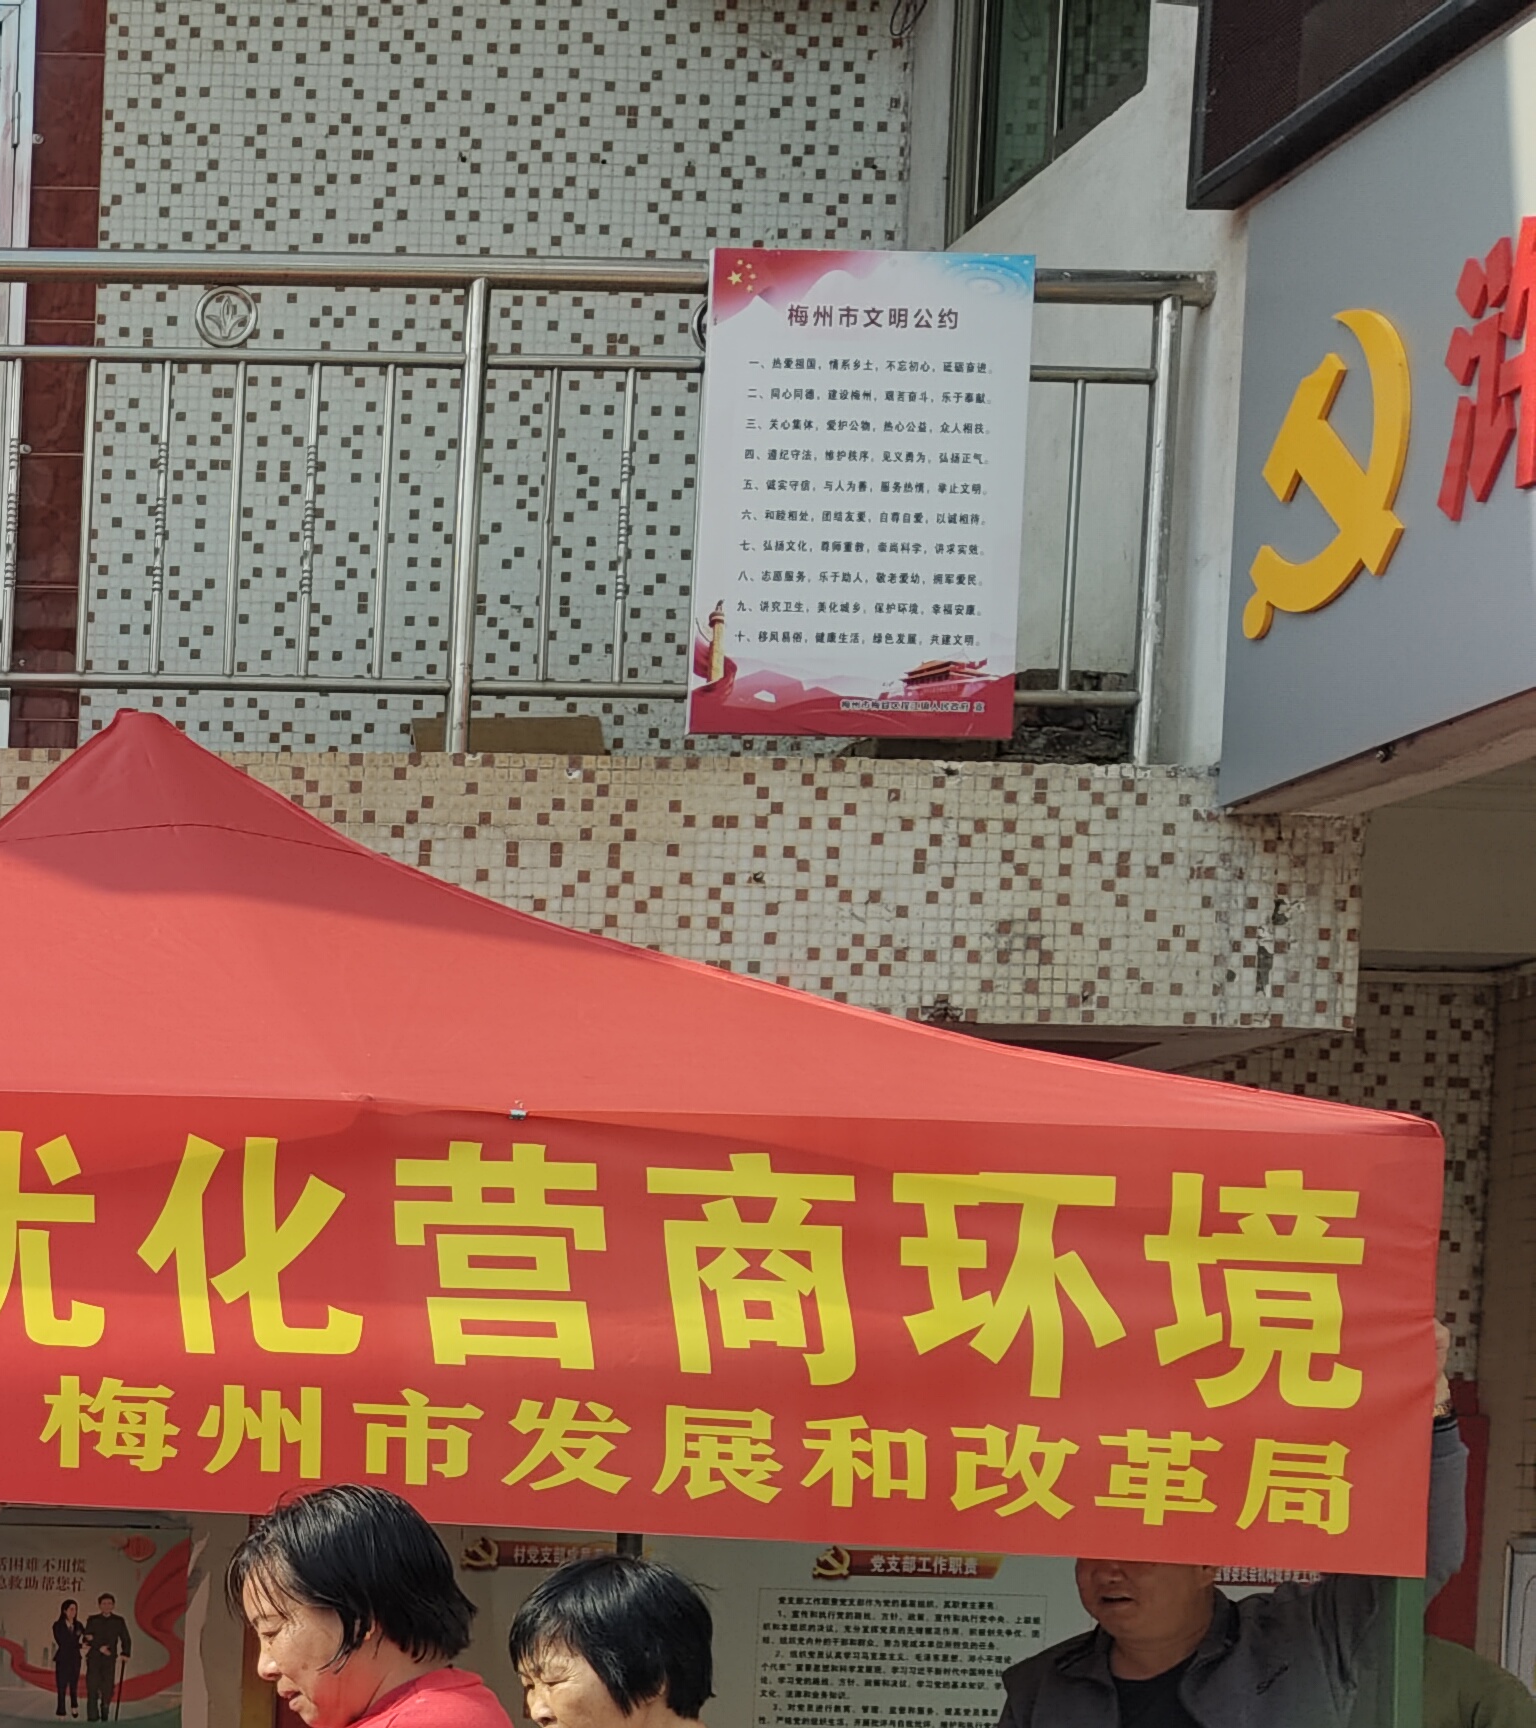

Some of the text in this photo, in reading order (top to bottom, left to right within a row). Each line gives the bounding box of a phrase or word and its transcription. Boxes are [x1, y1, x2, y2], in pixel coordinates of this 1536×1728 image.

[786, 304, 960, 331] 梅州市文明公约
[38, 1374, 1354, 1536] 梅州市发展和改革局
[870, 1554, 979, 1576] 党支部工作职责
